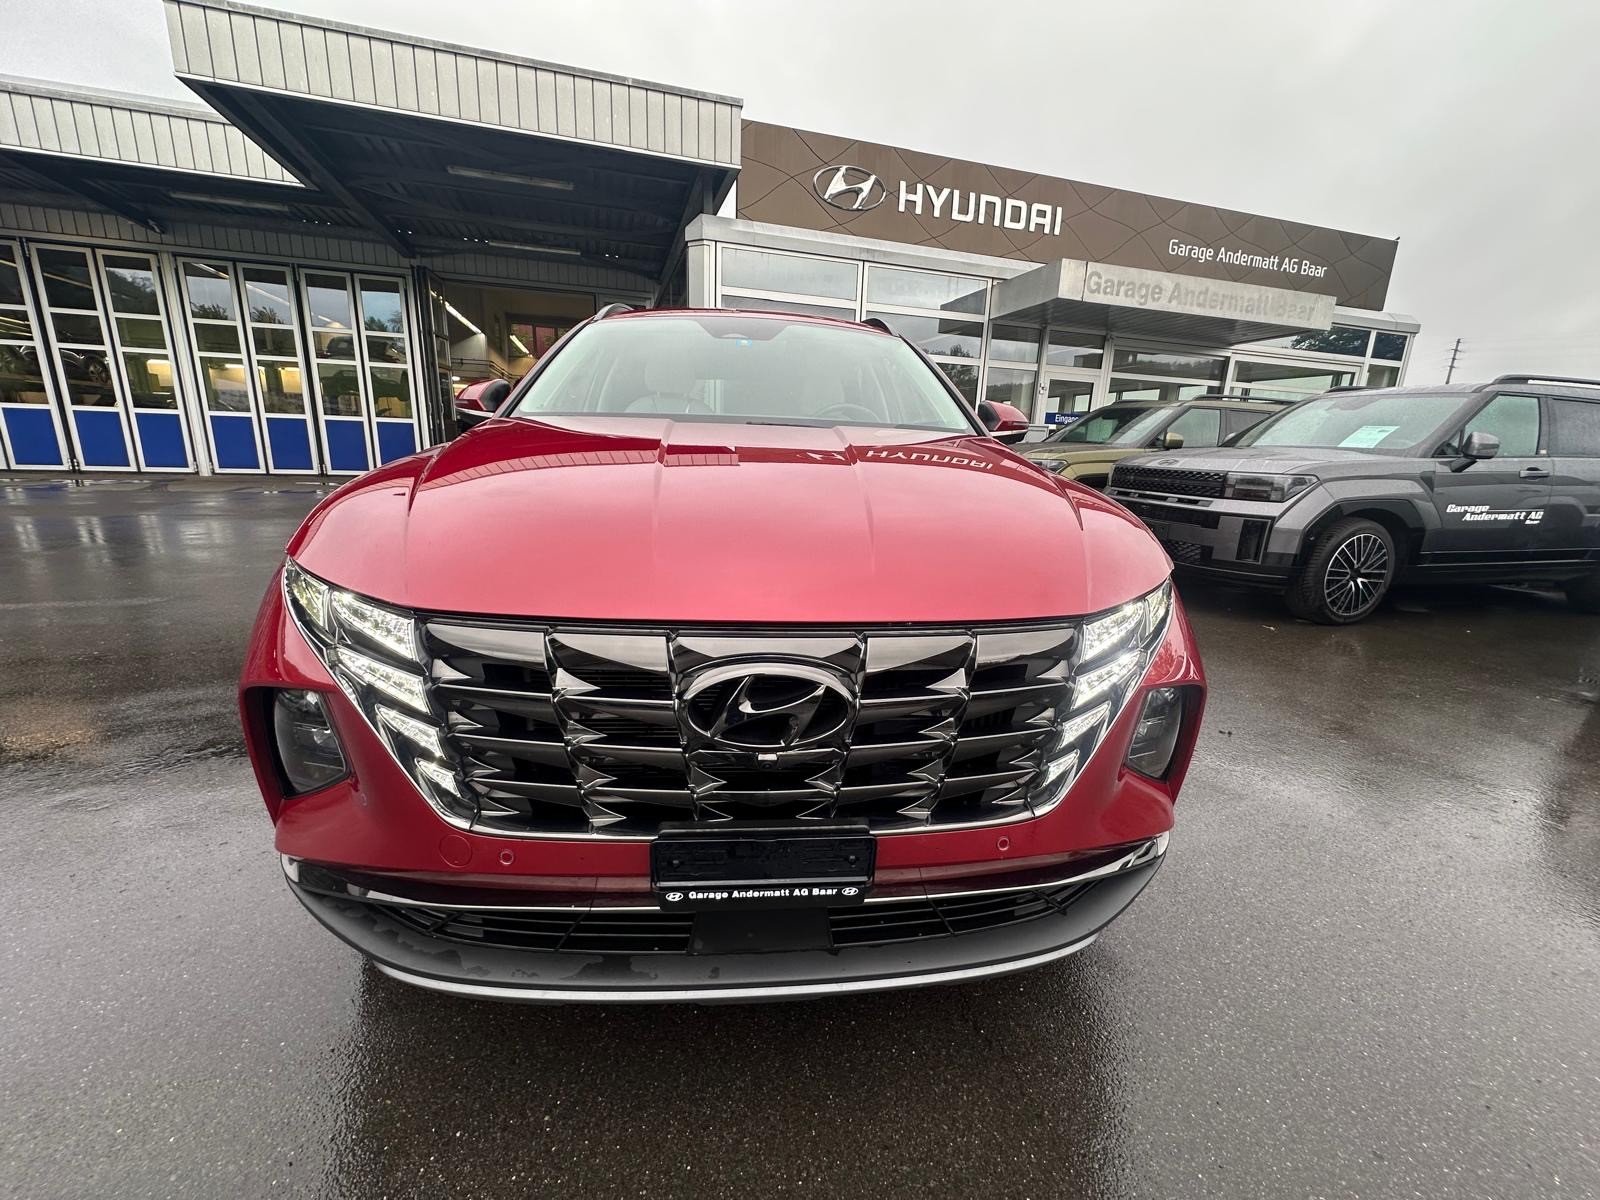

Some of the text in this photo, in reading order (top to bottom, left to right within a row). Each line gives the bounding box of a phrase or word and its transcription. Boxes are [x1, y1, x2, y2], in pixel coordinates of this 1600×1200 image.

[898, 180, 1062, 235] HYUNDAI
[1168, 239, 1328, 278] Garage Andermatt AG Baar
[1086, 270, 1163, 305] Garage
[1446, 504, 1490, 513] Garage
[1462, 511, 1544, 521] Andermatt AG
[688, 887, 838, 900] Garage Andermatt AG Baar
